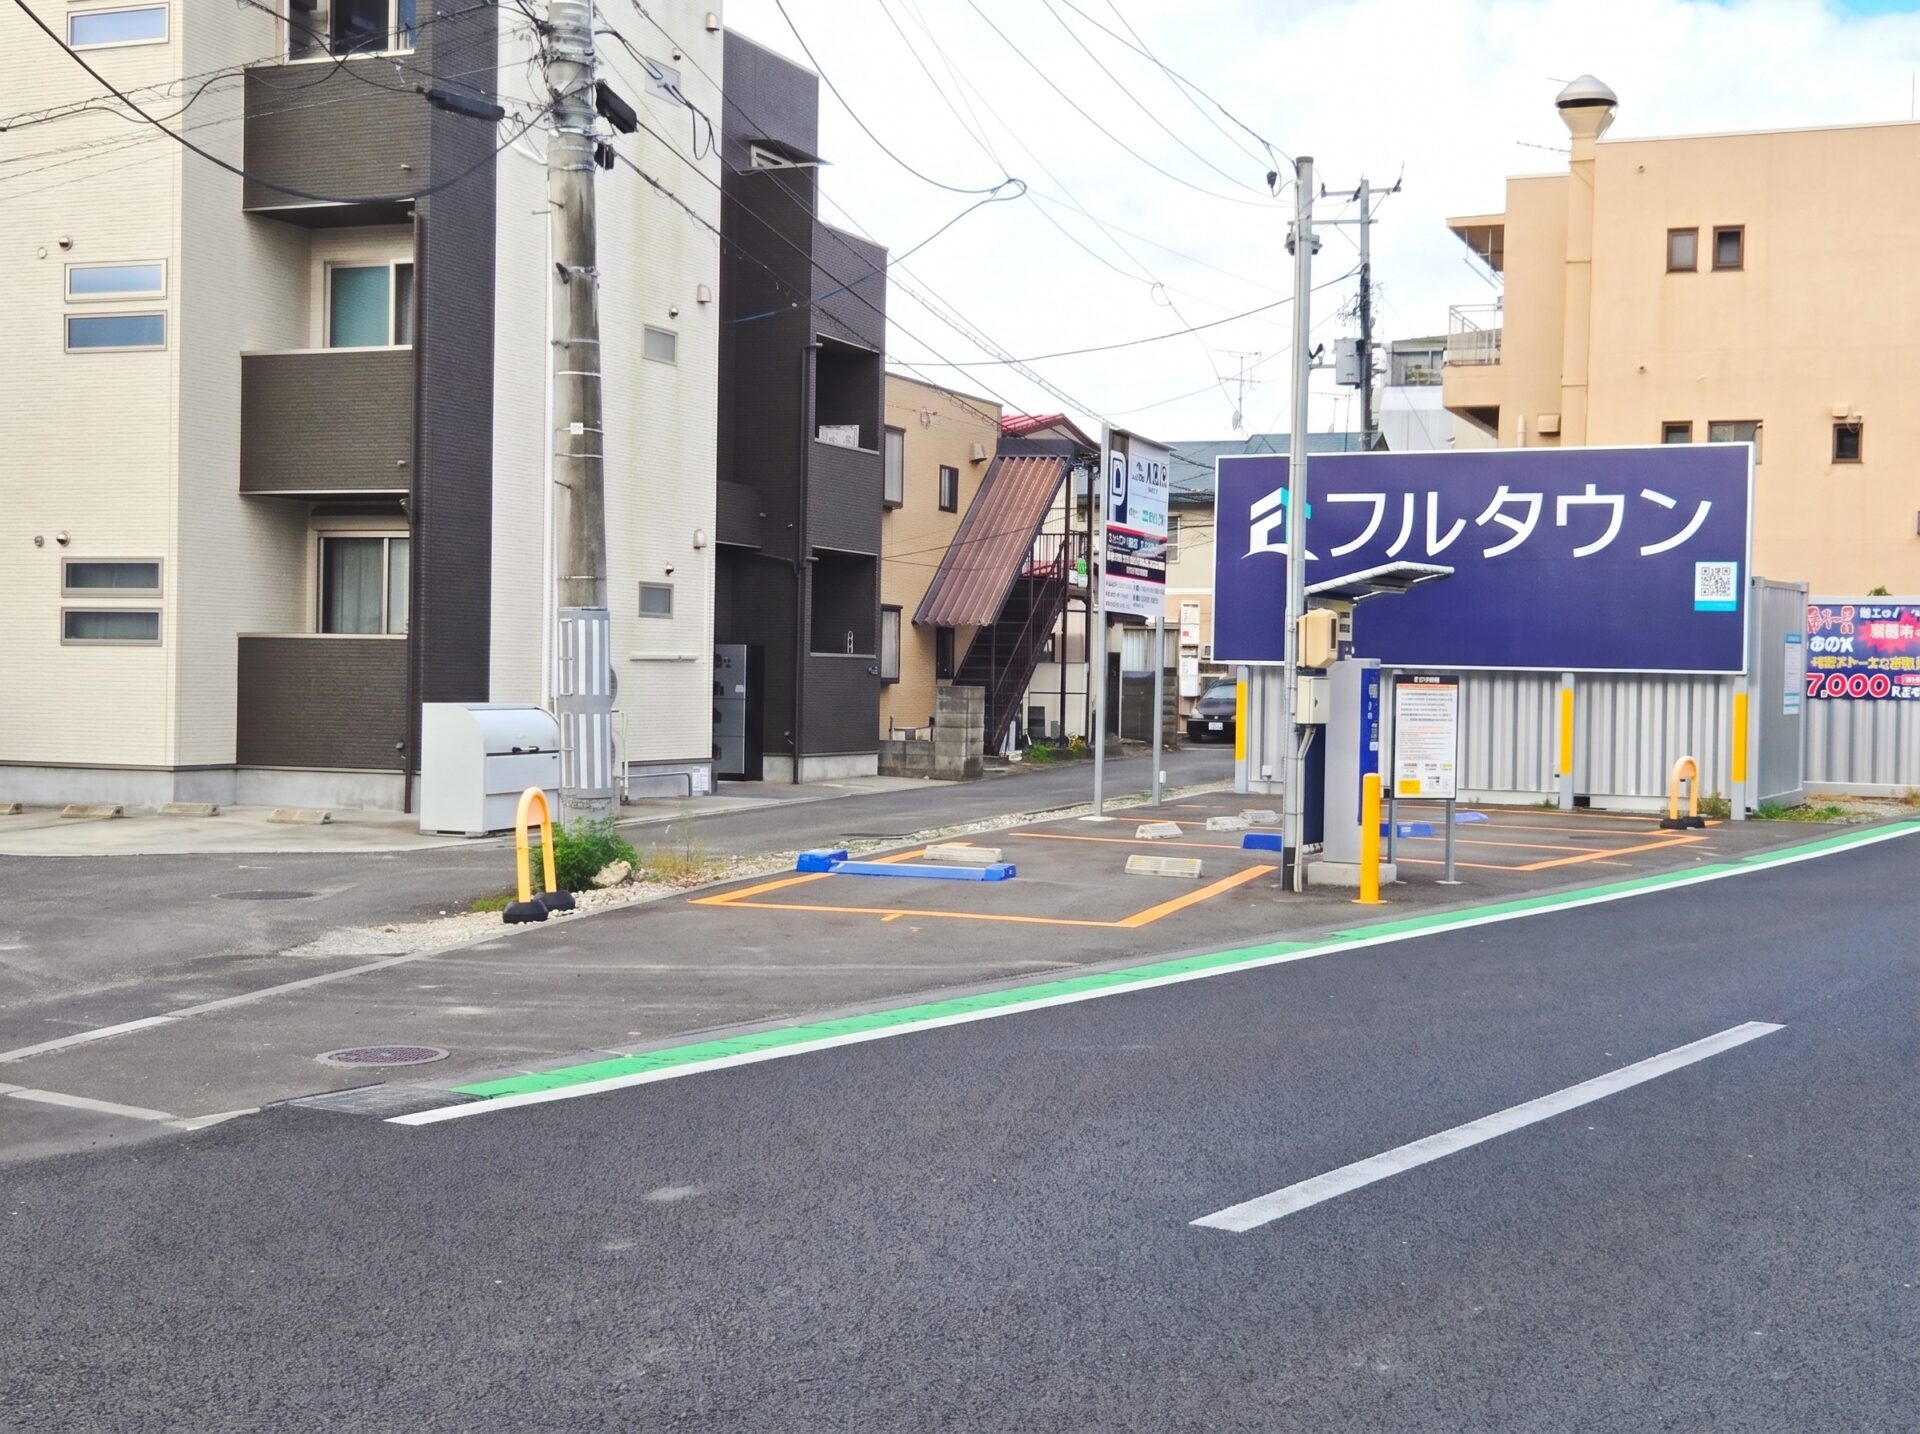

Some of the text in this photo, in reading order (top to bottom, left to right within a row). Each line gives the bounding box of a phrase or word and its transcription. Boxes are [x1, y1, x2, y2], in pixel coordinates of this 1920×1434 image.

[1326, 483, 1712, 560] フルタウン
